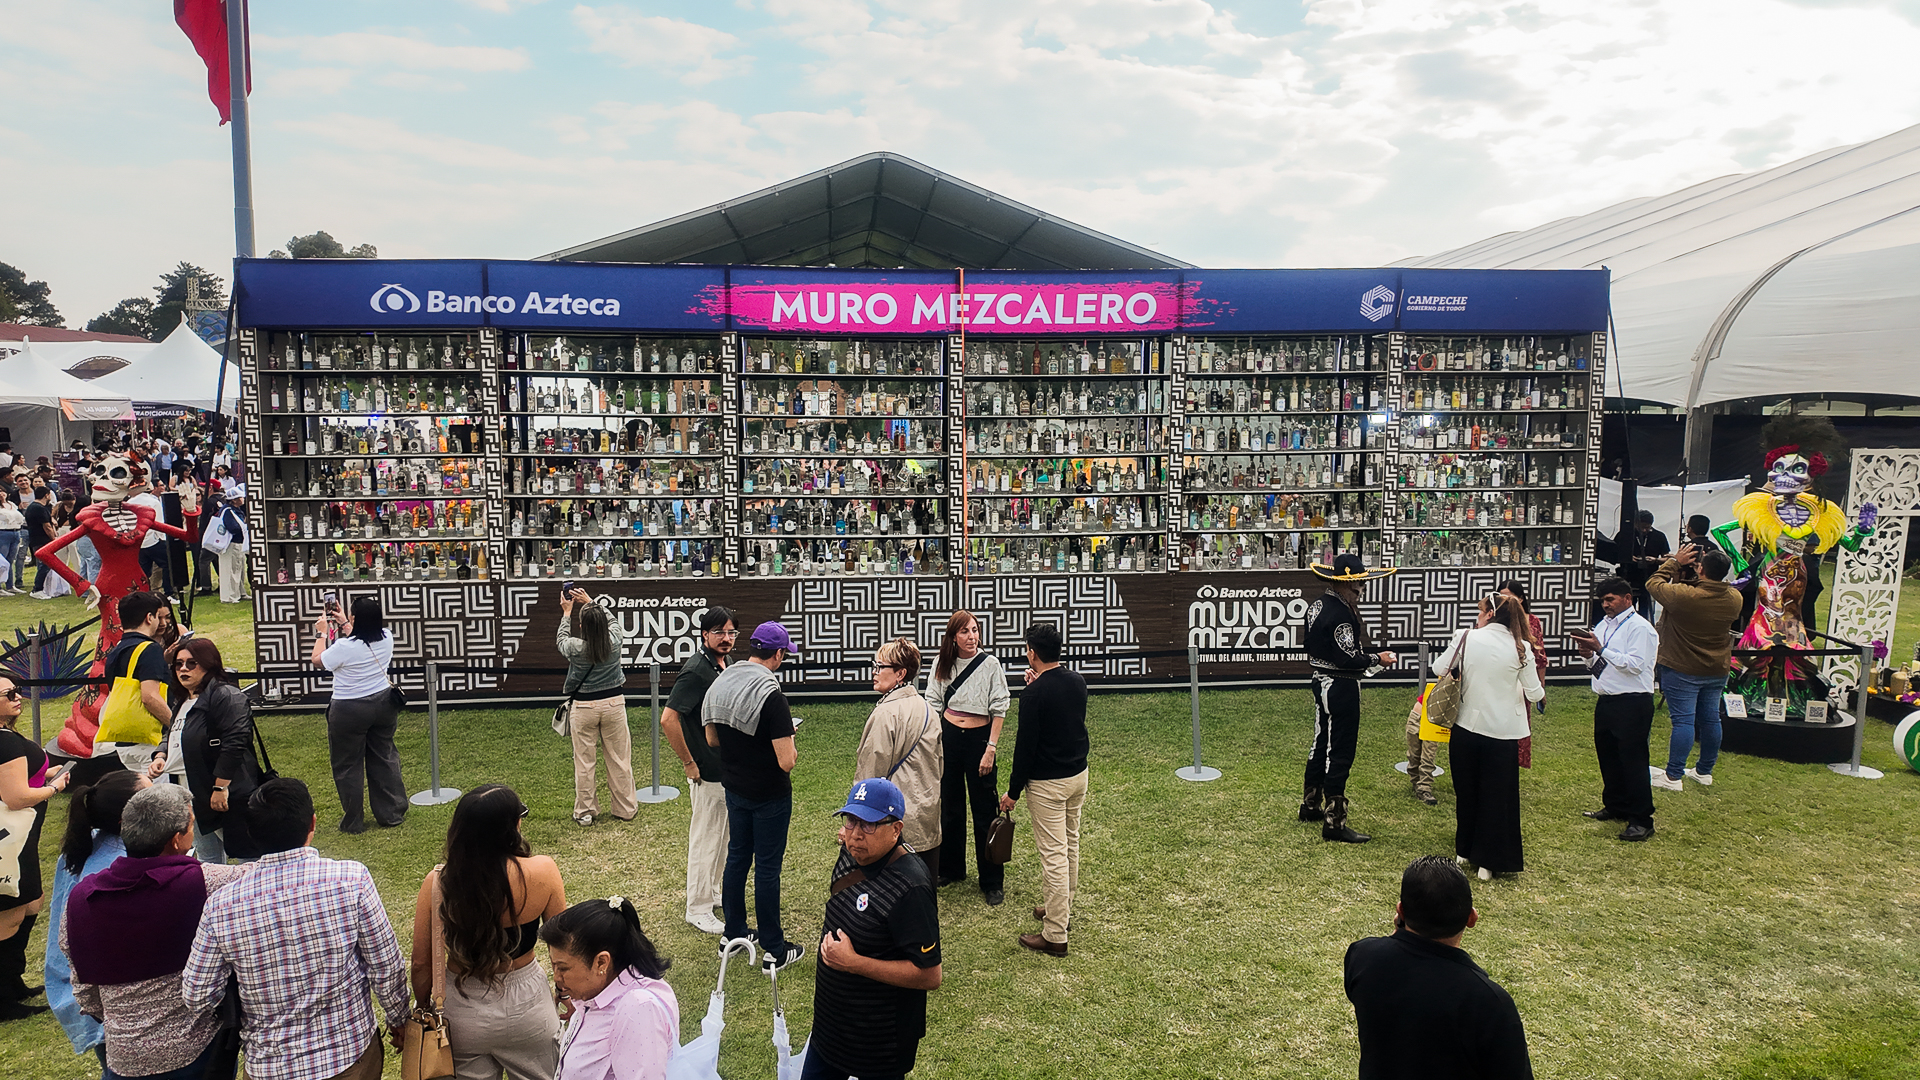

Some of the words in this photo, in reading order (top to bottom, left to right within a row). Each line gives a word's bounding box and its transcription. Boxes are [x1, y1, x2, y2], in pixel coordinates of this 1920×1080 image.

[426, 290, 516, 313] Banco
[521, 291, 621, 316] Azteca
[771, 290, 898, 325] MURO
[911, 292, 1158, 325] MEZCALERO
[1407, 295, 1468, 305] CAMPECHE
[617, 597, 659, 608] Banco
[660, 596, 707, 607] Azteca
[1220, 587, 1258, 598] Banco
[1259, 586, 1302, 598] Azteca
[1188, 598, 1309, 629] MUNDO
[1188, 626, 1305, 649] MEZCAL
[620, 636, 702, 664] EZCA
[1218, 653, 1230, 663] DEL
[1231, 653, 1255, 663] AGAVE,
[1256, 653, 1279, 662] TIERRA
[1280, 653, 1285, 662] Y
[854, 783, 868, 801] LA
